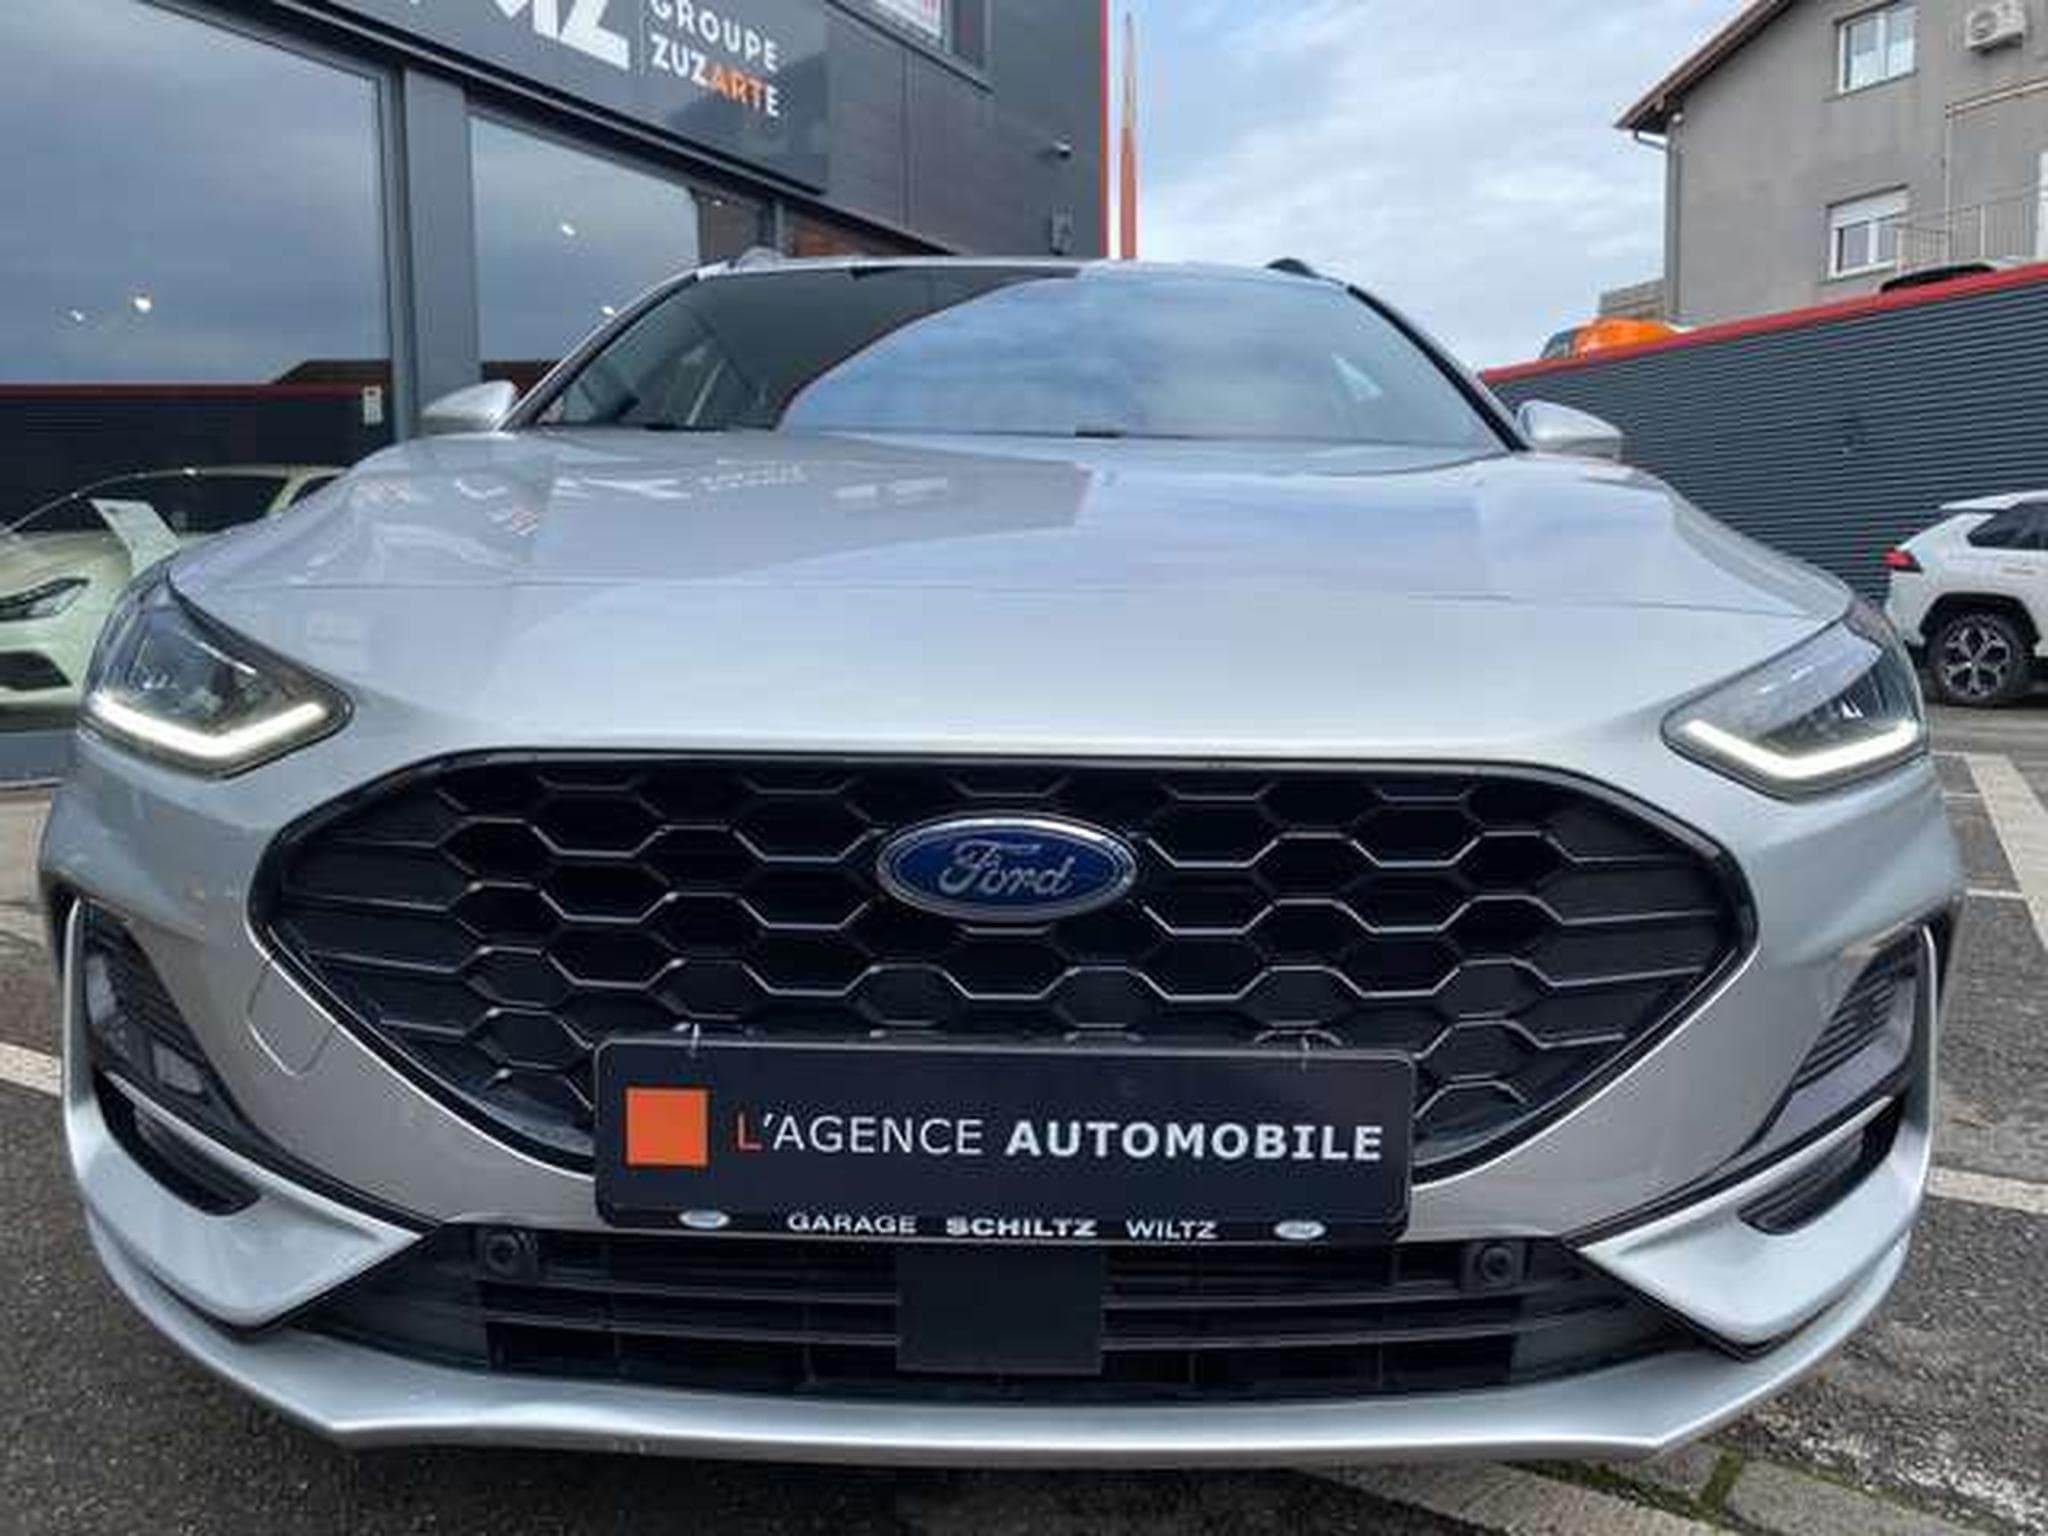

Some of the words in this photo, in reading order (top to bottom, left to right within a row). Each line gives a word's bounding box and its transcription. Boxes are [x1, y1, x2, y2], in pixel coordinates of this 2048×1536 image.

[650, 0, 778, 72] GROUPE
[650, 32, 779, 117] ZUZARTE
[938, 840, 1076, 895] Ford
[1005, 1120, 1384, 1162] AUTOMOBILE
[786, 1212, 917, 1235] GARAGE
[945, 1216, 1099, 1238] SCHILTZ
[1125, 1218, 1219, 1240] WILTZ
